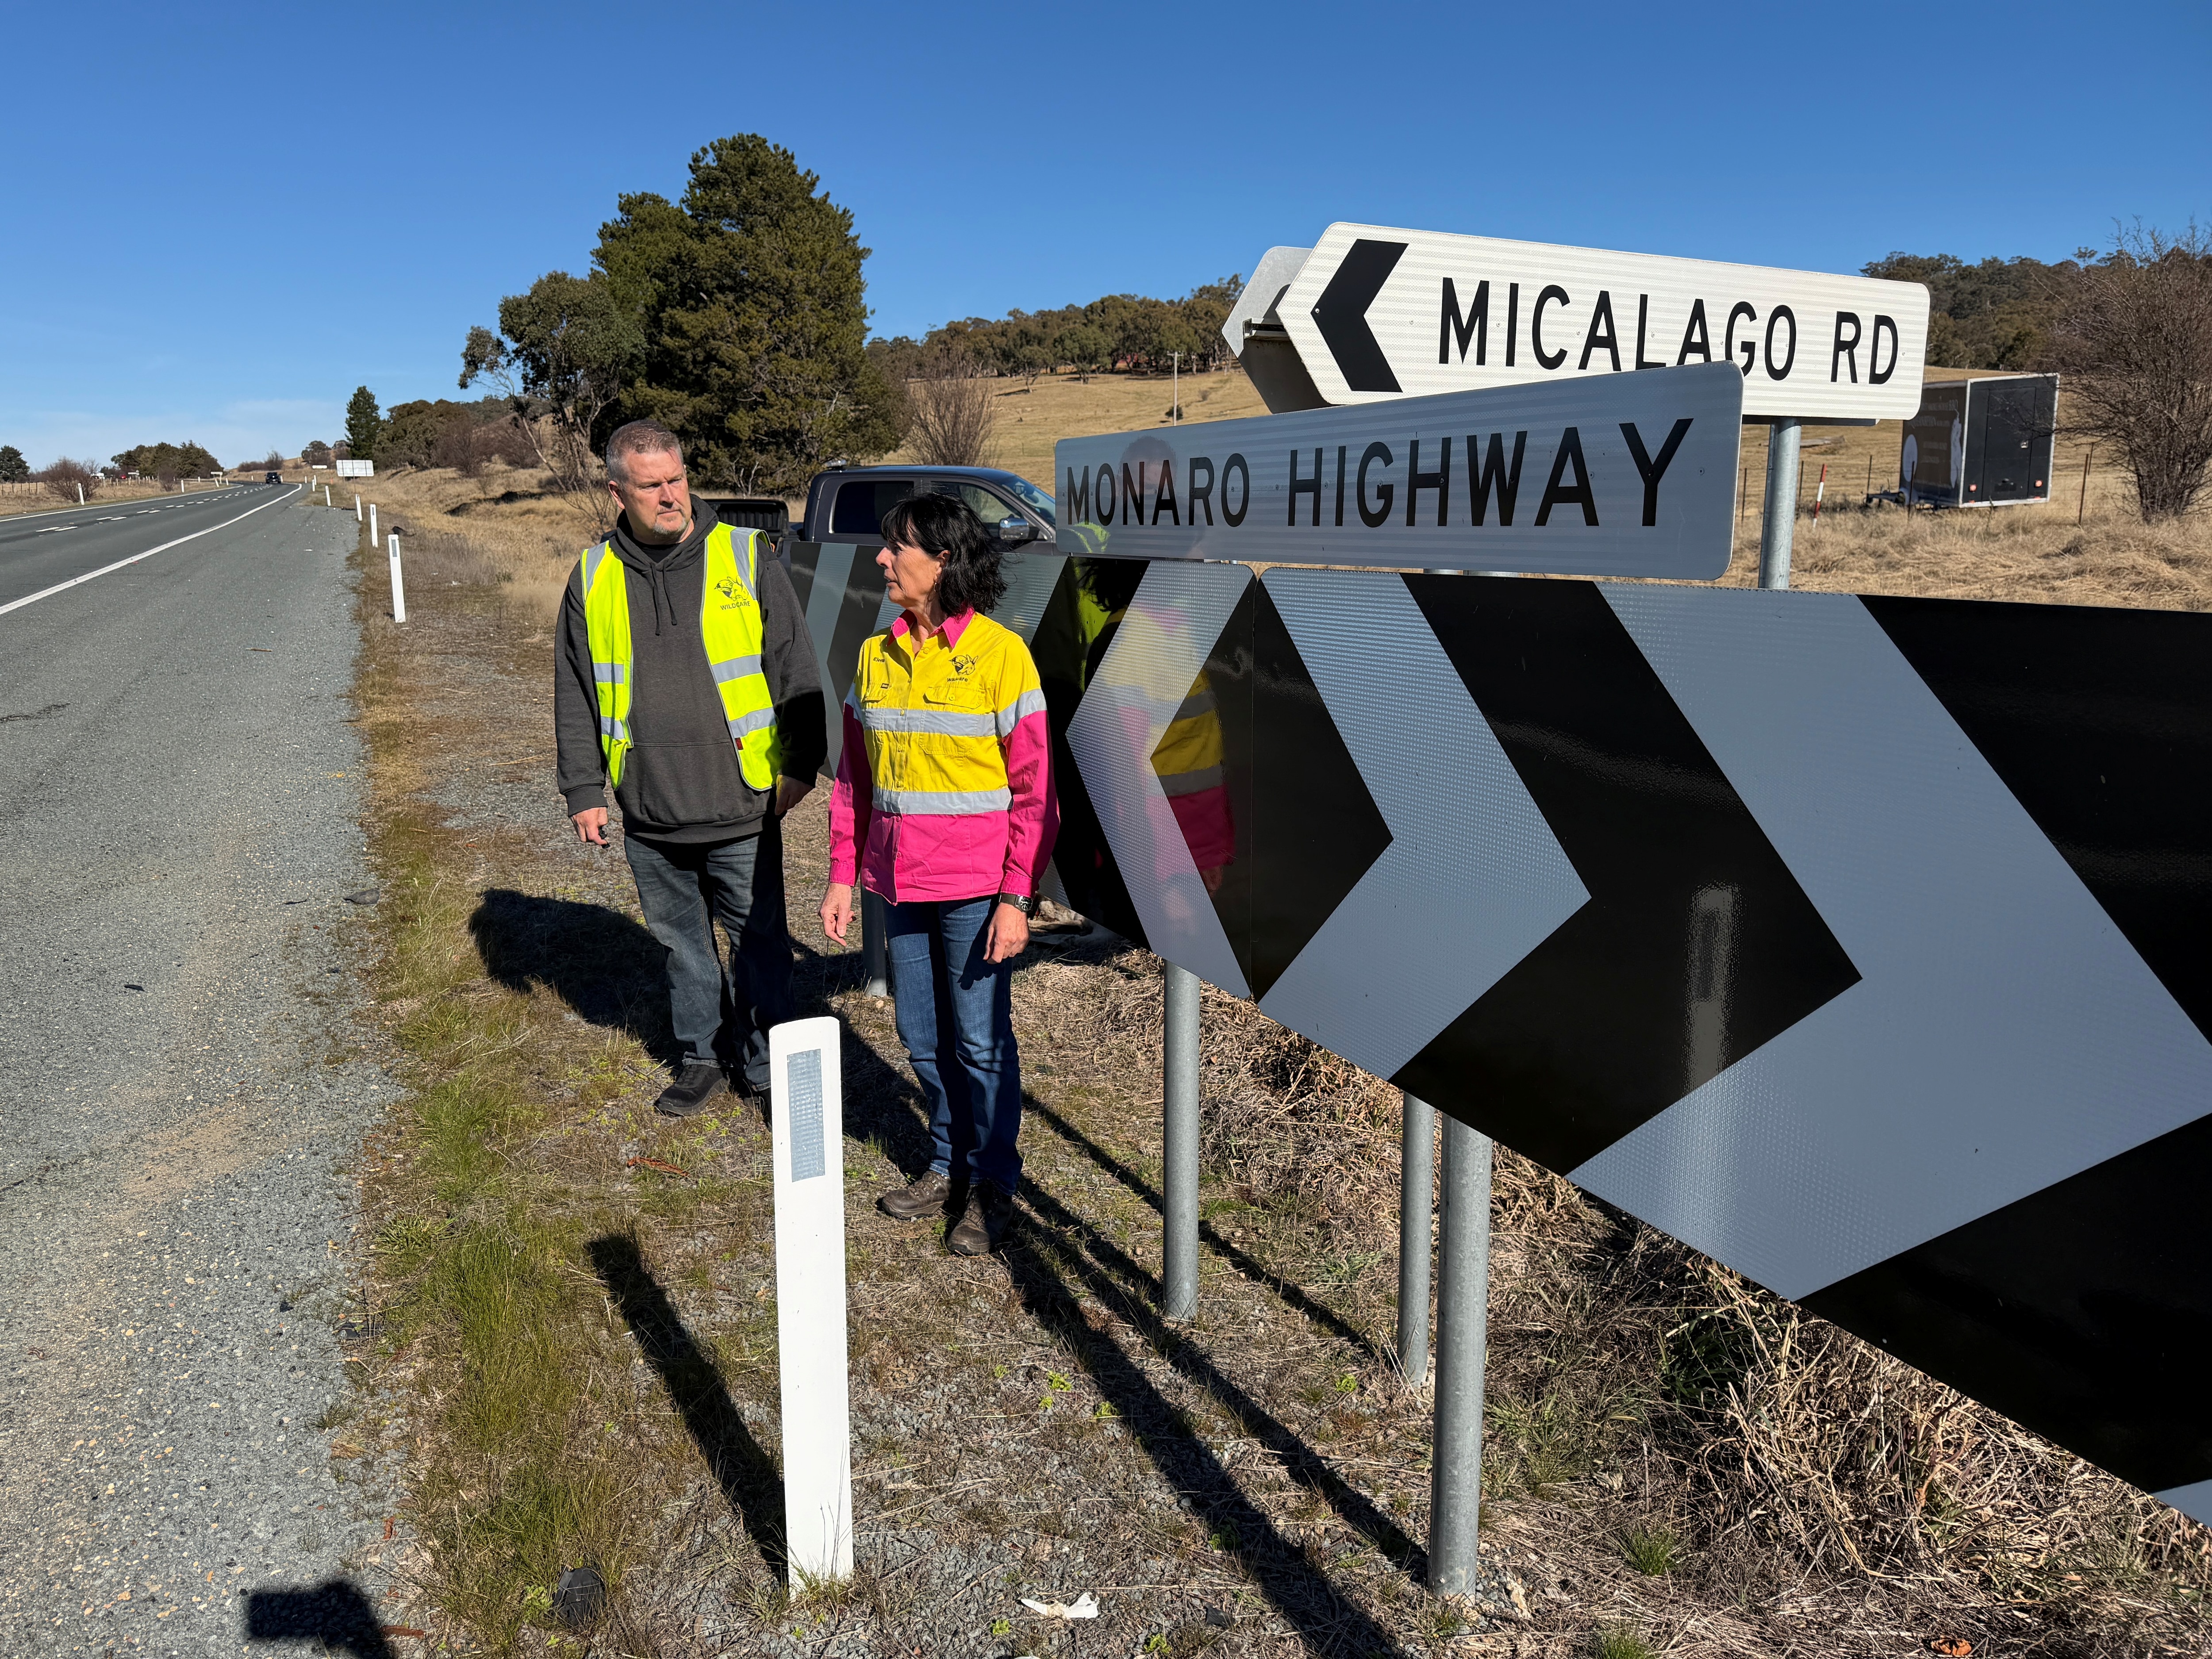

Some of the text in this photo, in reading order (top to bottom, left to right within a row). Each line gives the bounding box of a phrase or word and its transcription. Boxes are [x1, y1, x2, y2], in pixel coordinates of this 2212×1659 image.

[1438, 276, 1899, 385] MICALAGO RD
[1067, 417, 1694, 528] MONARO HIGHWAY
[720, 601, 750, 610] WILDCARE
